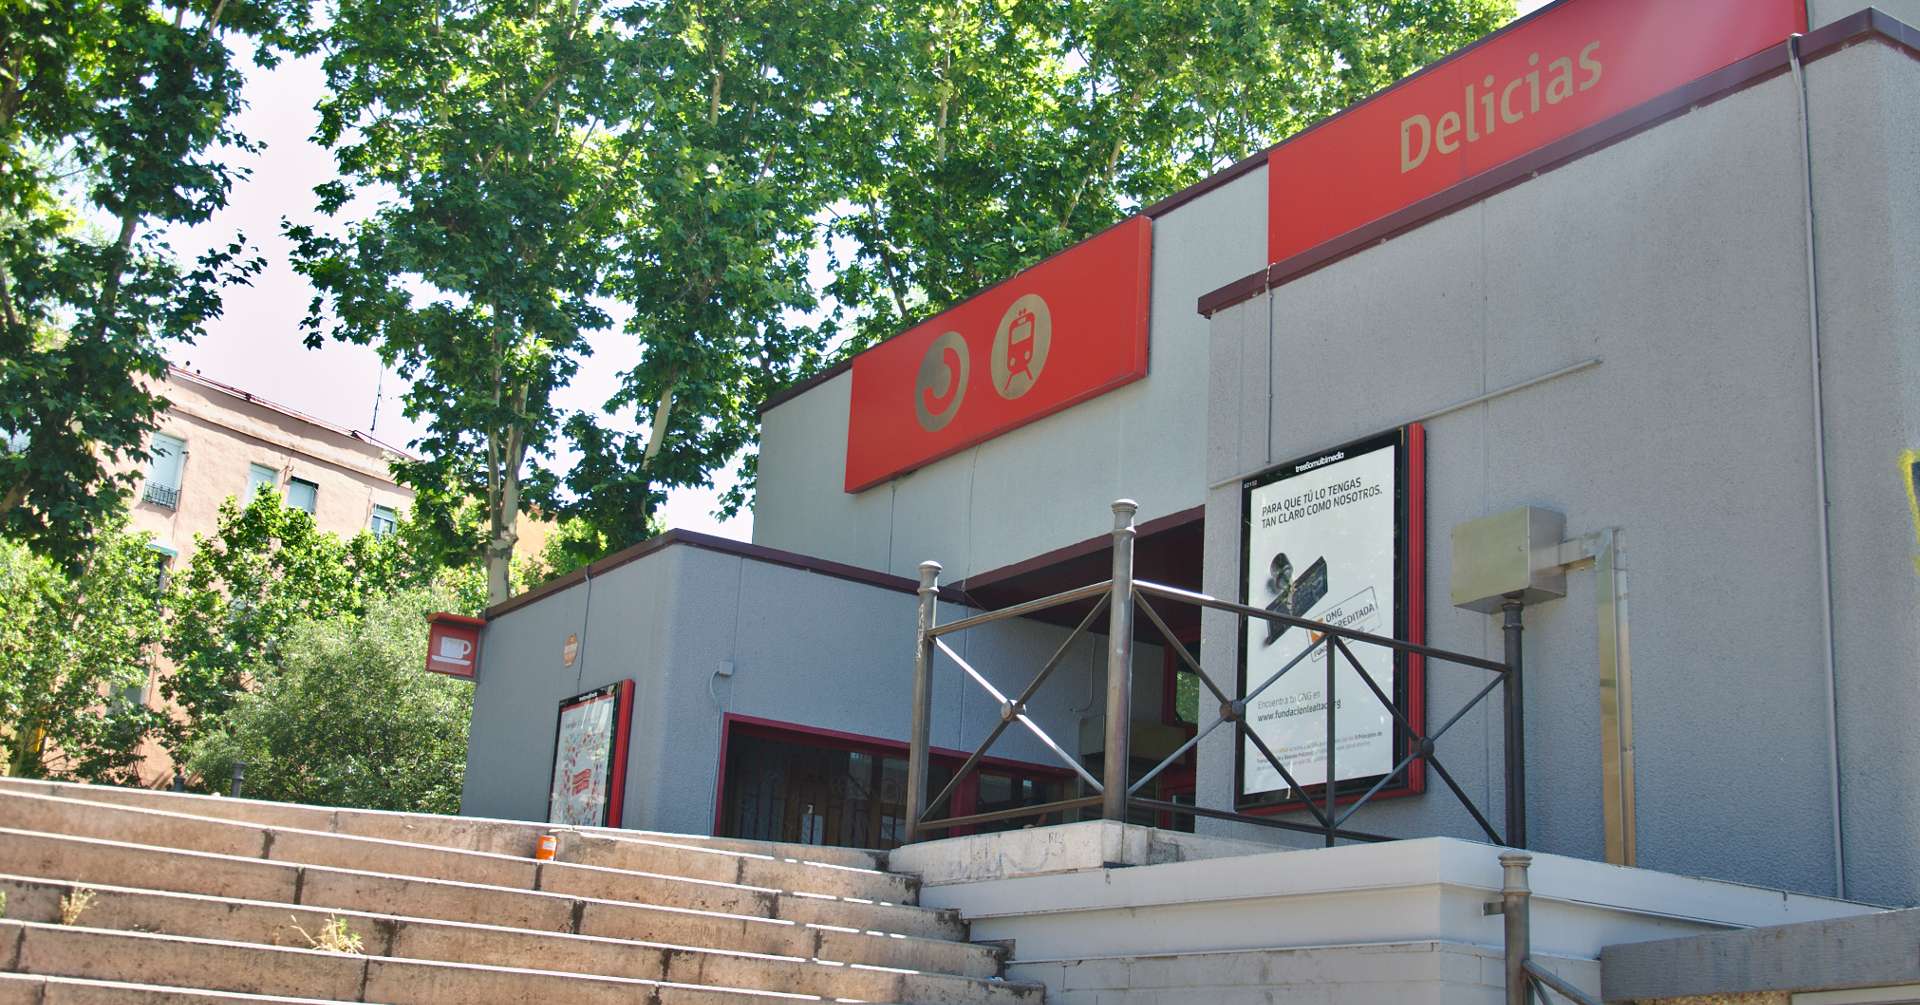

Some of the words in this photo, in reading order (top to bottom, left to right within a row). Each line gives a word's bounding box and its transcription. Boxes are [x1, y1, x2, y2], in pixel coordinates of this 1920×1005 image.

[1401, 41, 1601, 173] Delicias
[1262, 502, 1282, 517] PARA
[1284, 496, 1301, 511] QUE
[1303, 489, 1313, 503] TÚ
[1315, 488, 1326, 501] LO
[1328, 477, 1361, 496] TENGAS
[1262, 515, 1277, 528] TAN
[1278, 508, 1305, 524] CLARO
[1306, 500, 1331, 516] COMO
[1333, 485, 1382, 507] NOSOTROS.
[1325, 608, 1343, 623] ONG
[1334, 603, 1375, 627] REDITADA
[1298, 691, 1311, 702] ONG
